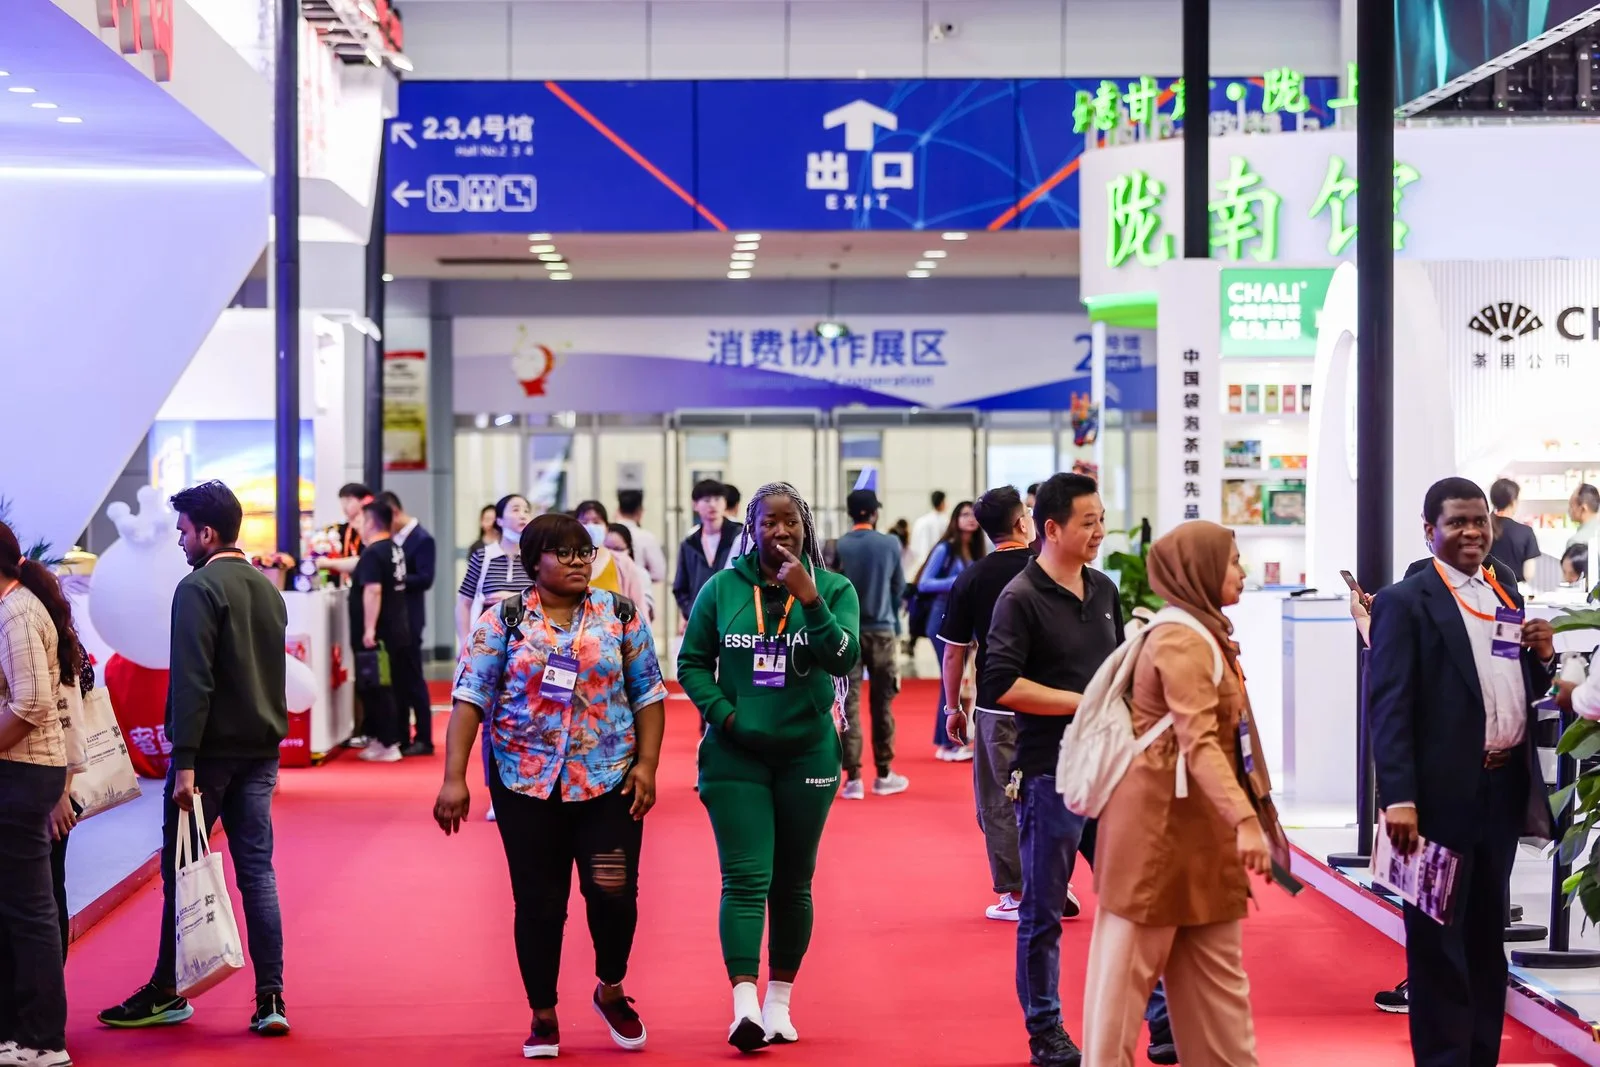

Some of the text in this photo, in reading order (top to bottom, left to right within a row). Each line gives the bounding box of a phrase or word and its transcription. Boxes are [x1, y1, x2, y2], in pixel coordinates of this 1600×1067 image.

[422, 114, 534, 142] 2.3.4号馆
[806, 151, 914, 190] 出口
[826, 193, 890, 210] EXIT
[1227, 282, 1301, 304] CHALI
[707, 329, 947, 367] 消费协作展区
[1183, 348, 1200, 519] 中国袋泡茶领先品
[724, 632, 809, 649] ESSIA
